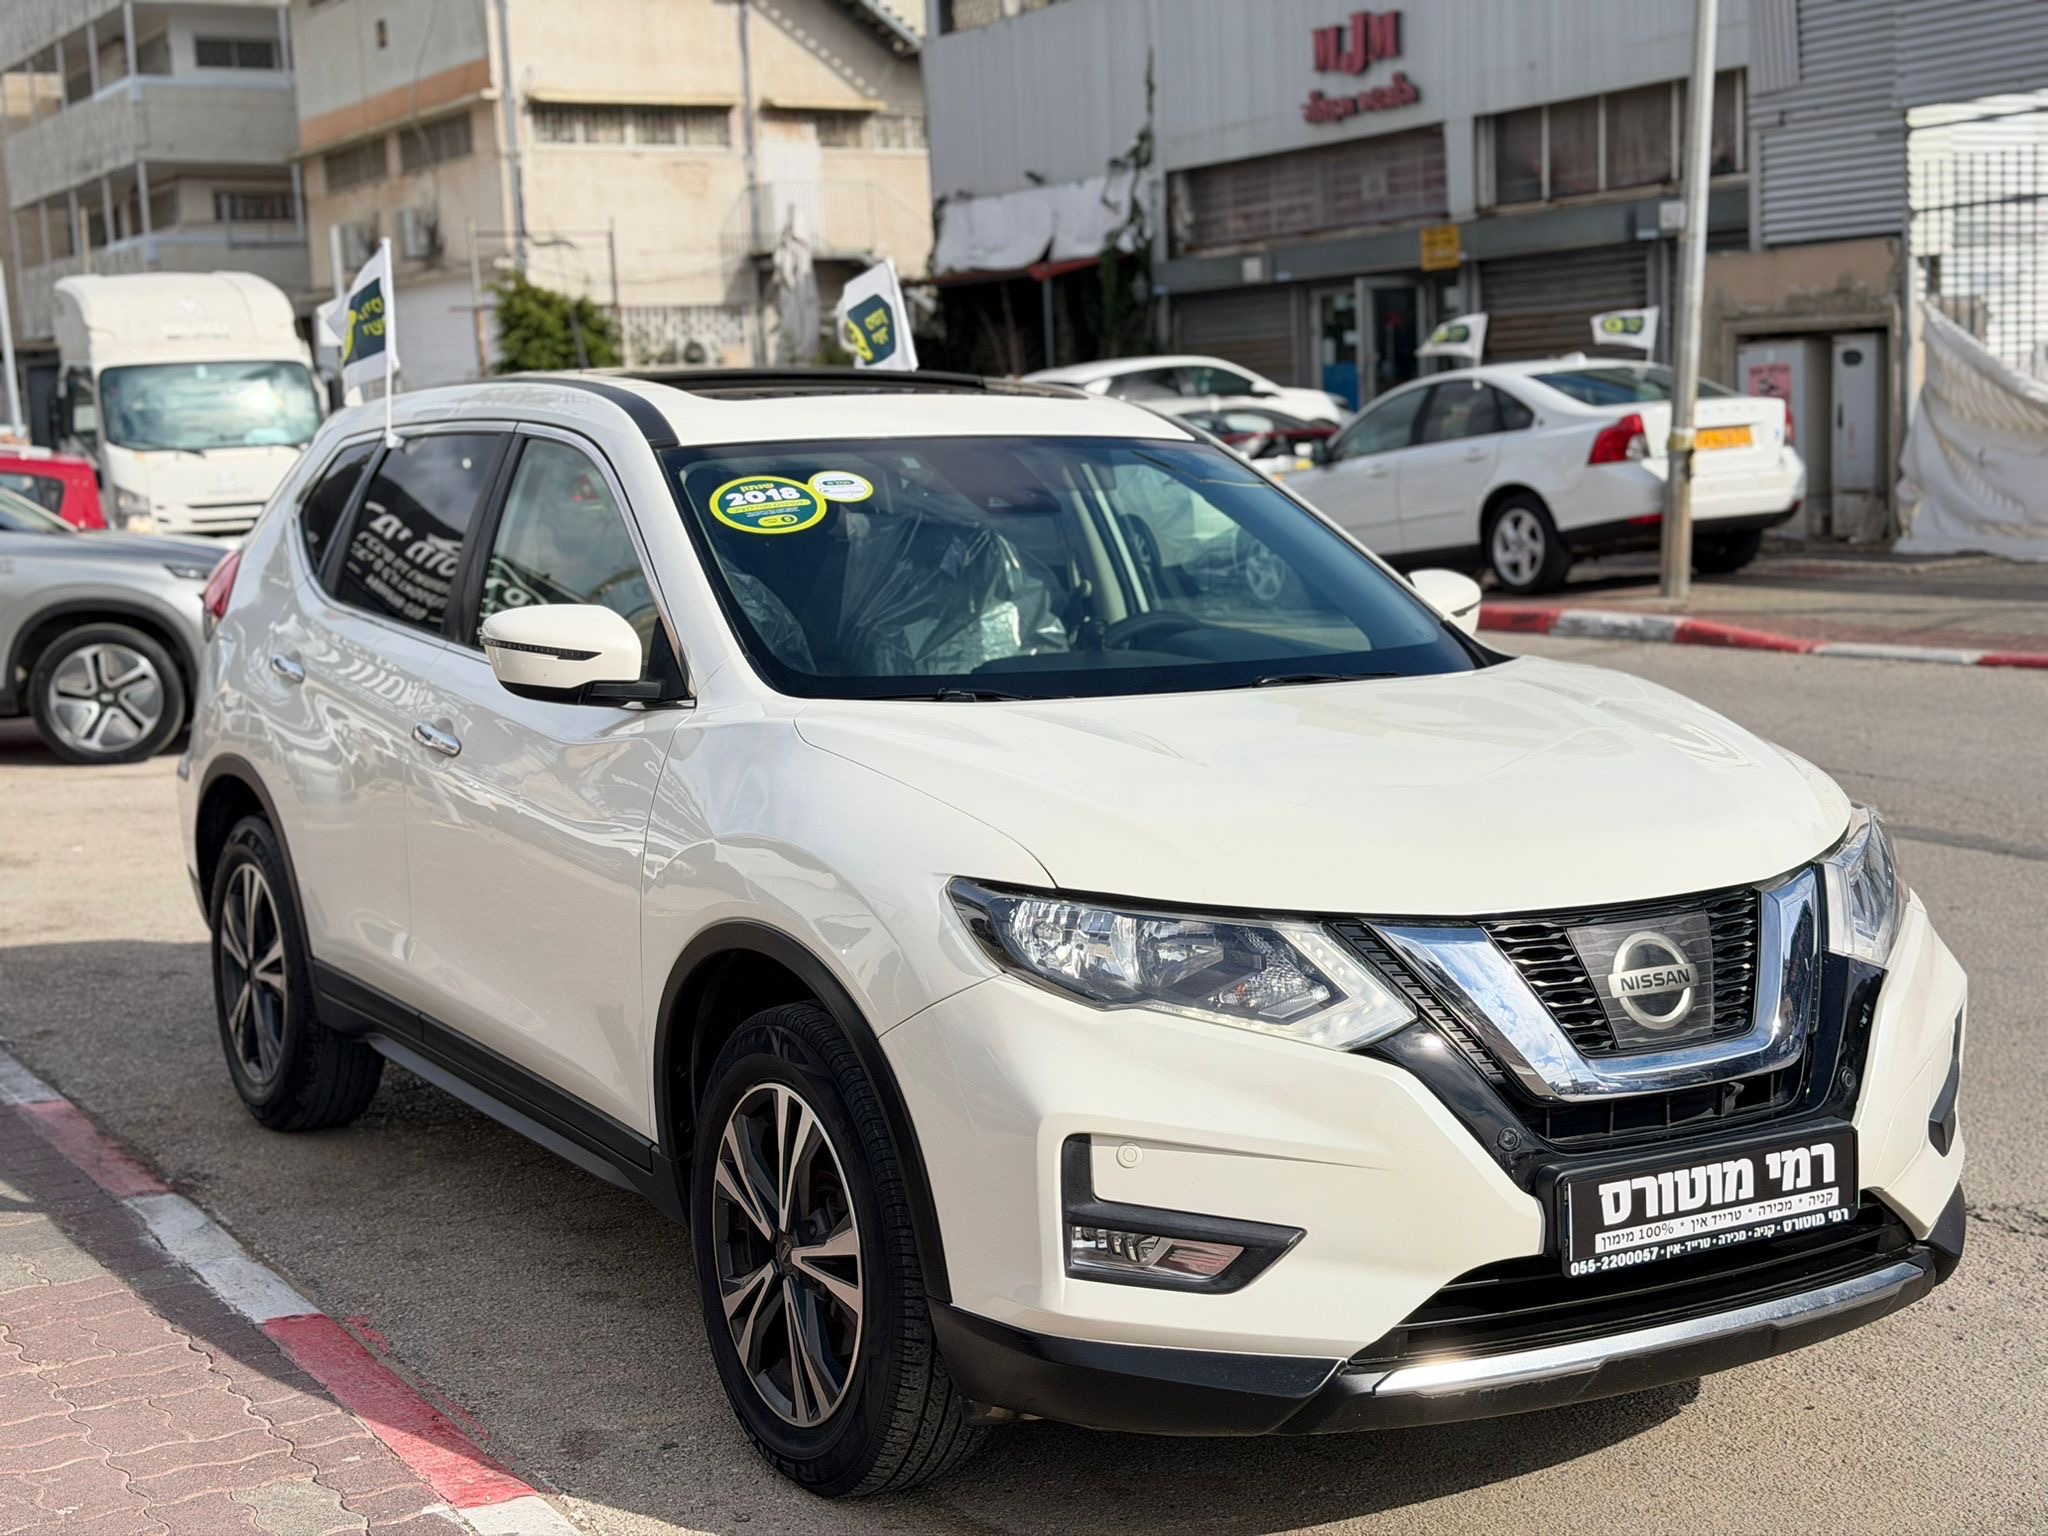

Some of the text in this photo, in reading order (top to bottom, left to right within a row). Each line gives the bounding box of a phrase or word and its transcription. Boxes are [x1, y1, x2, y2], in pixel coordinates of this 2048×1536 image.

[725, 486, 801, 507] 2018
[1620, 968, 1690, 991] NISSAN
[1598, 1142, 1836, 1227] רמי מוטורס
[1601, 1191, 1833, 1251] קניה מכירה טרייד אין 100% מימון
[1782, 1213, 1826, 1233] מוטורס
[1828, 1207, 1849, 1223] רמי
[1718, 1230, 1747, 1245] מכירה
[1753, 1224, 1775, 1238] קניה
[1570, 1247, 1659, 1277] 055-2200057
